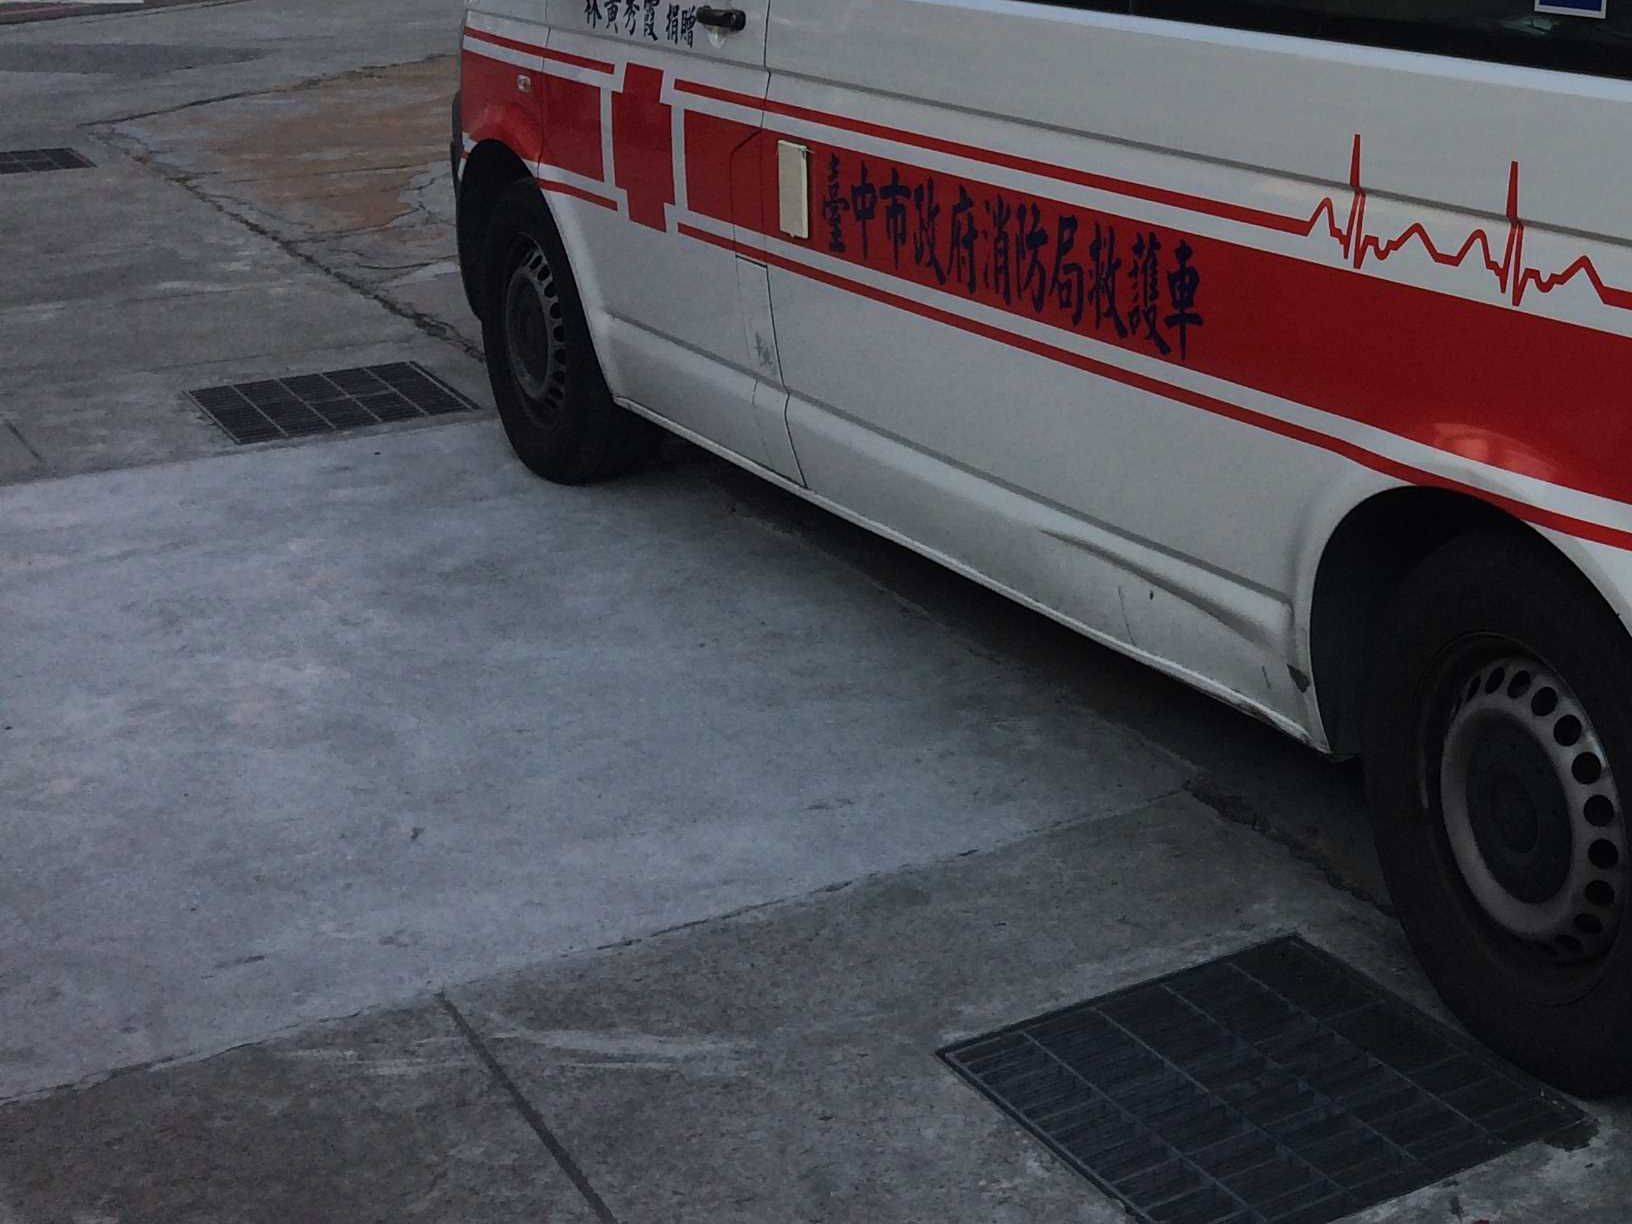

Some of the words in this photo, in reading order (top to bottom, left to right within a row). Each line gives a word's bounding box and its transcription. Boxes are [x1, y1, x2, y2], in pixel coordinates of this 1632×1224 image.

[665, 2, 697, 49] 捐贈
[821, 152, 1204, 361] 臺中市政府消防局救護車
